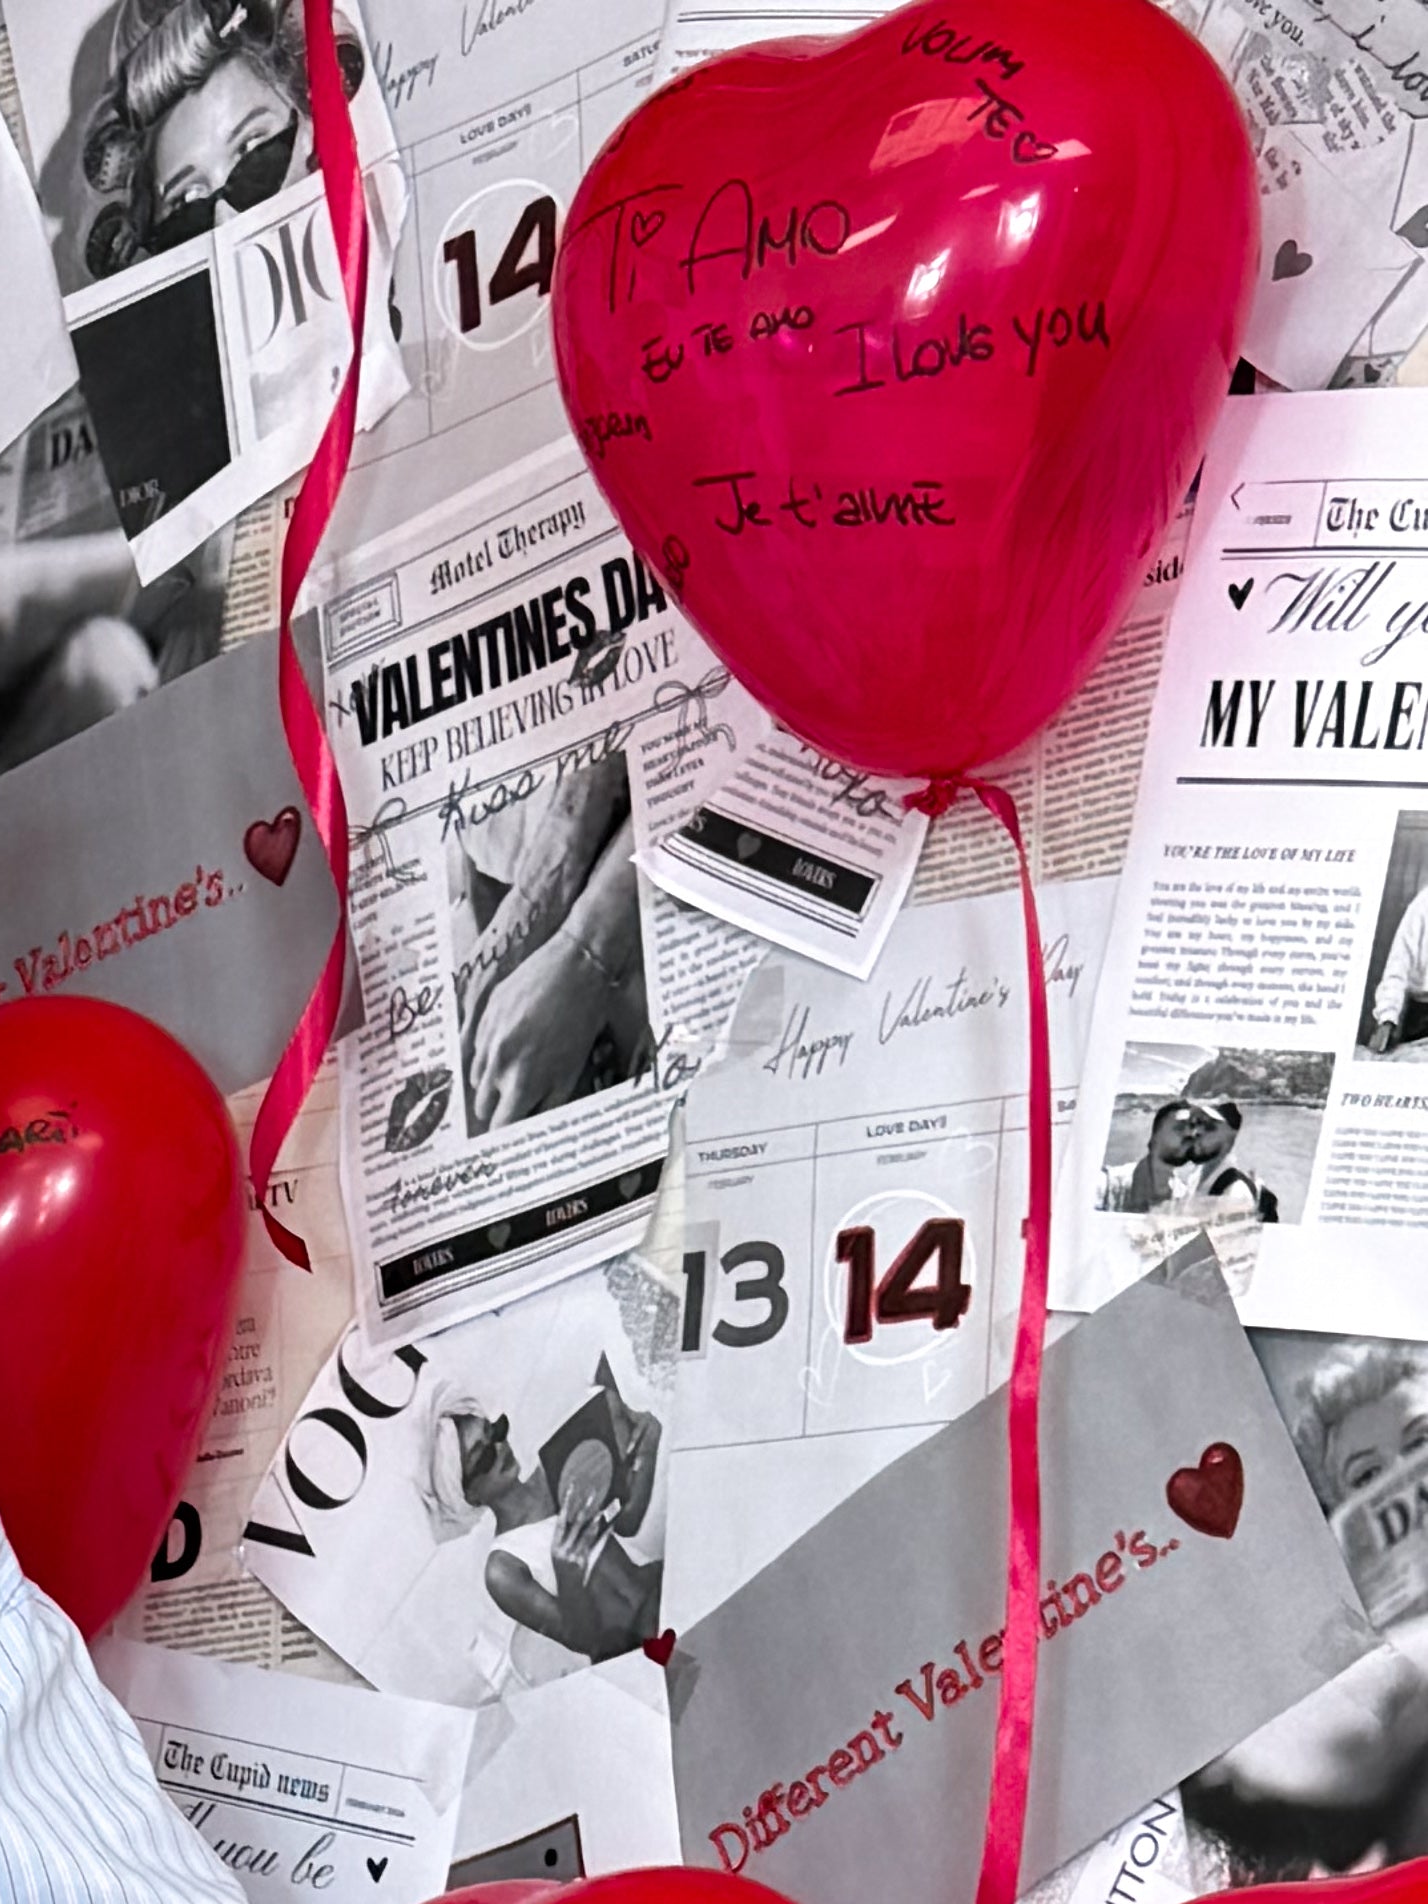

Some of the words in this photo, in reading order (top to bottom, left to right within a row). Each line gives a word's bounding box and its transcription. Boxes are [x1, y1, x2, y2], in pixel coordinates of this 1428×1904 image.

[443, 195, 556, 334] 14
[683, 179, 851, 292] AMO
[702, 320, 733, 354] TE
[693, 473, 772, 534] Je
[1327, 497, 1380, 537] The
[428, 541, 492, 595] Motel
[497, 498, 586, 557] Therapy
[1264, 561, 1396, 635] Will
[349, 576, 594, 747] VALENTINES
[380, 735, 439, 790] KEEP
[446, 679, 573, 763] BELIEVING
[612, 629, 678, 696] LOVE
[1200, 679, 1275, 748] MY
[1215, 846, 1238, 859] THE
[1242, 846, 1278, 861] LOVE
[762, 1004, 855, 1081] Happy
[878, 974, 1011, 1048] Valentine's
[697, 1141, 769, 1165] THURSDAY
[866, 1121, 908, 1140] LOVE
[680, 1239, 791, 1353] 13
[835, 1216, 972, 1346] 14
[164, 1738, 205, 1778] The
[210, 1752, 273, 1791] Cupid
[276, 1776, 331, 1804] news
[709, 1709, 906, 1876] Different
